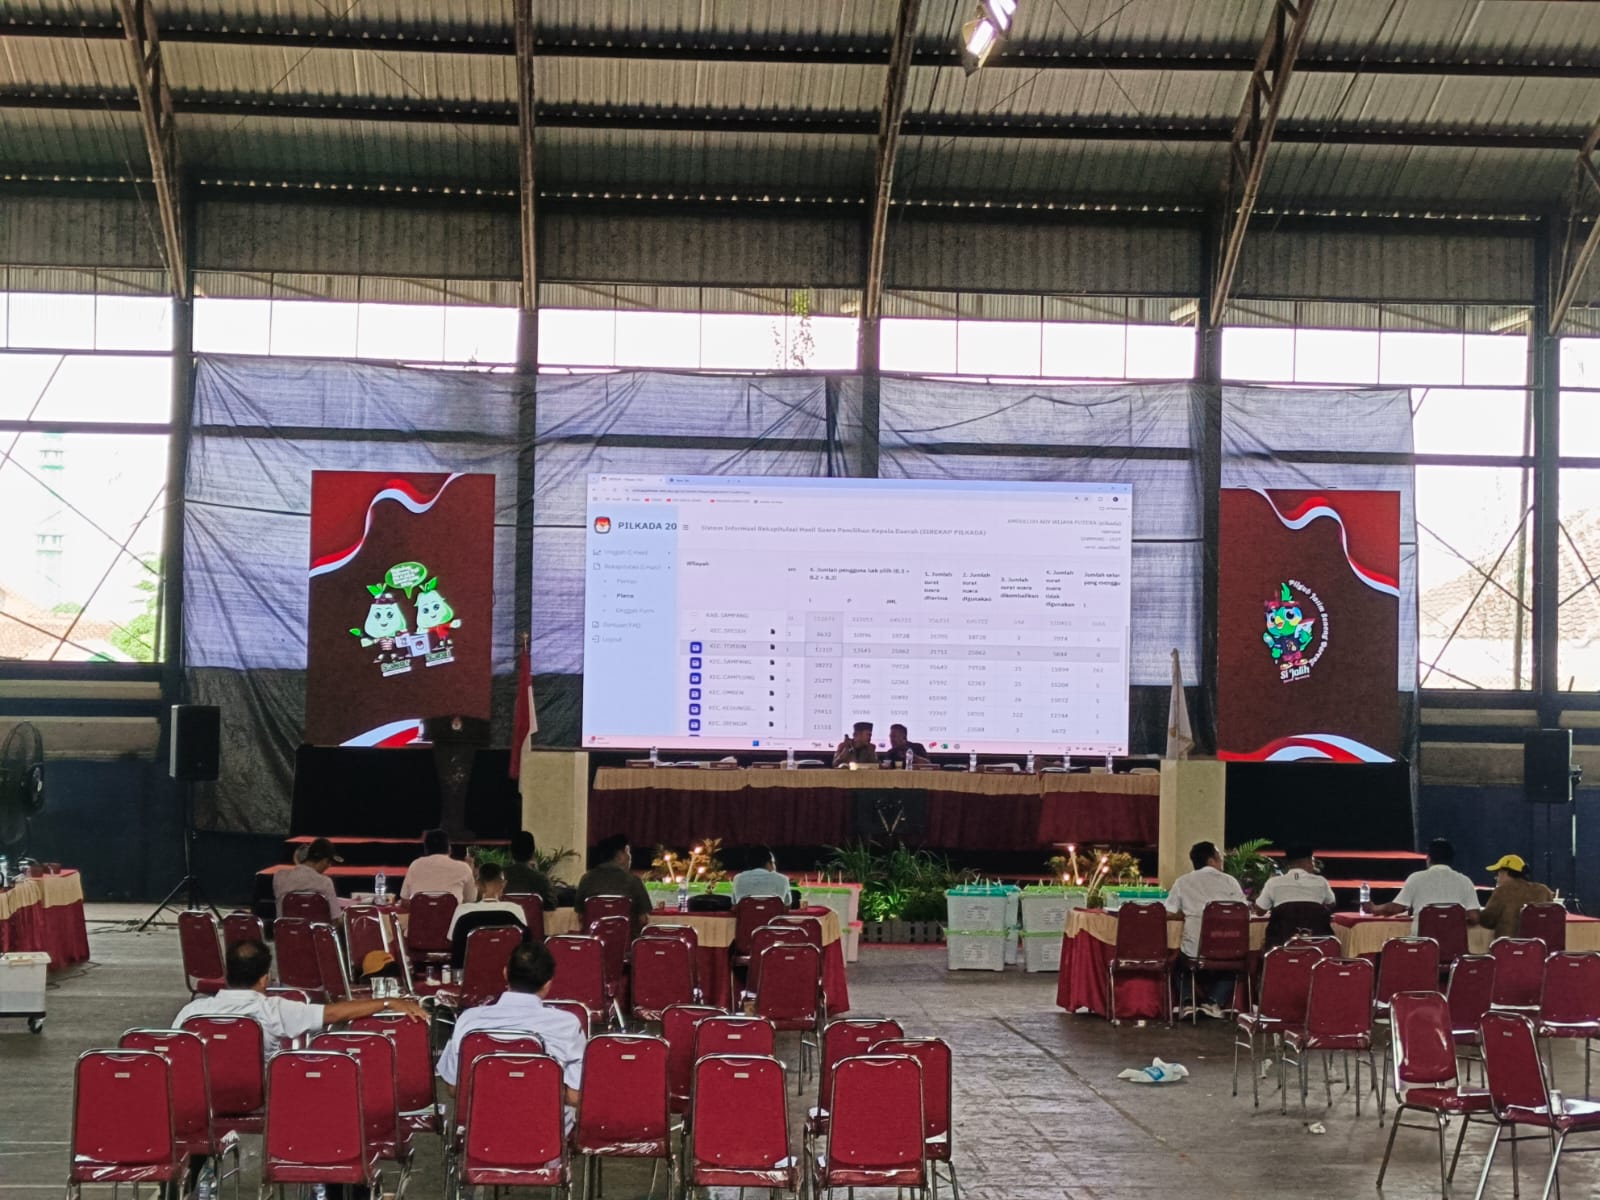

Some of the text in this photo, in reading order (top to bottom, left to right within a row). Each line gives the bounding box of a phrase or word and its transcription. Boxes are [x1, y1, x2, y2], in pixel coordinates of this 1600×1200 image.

[618, 521, 678, 531] PILKADA 20
[1280, 670, 1289, 680] Si
